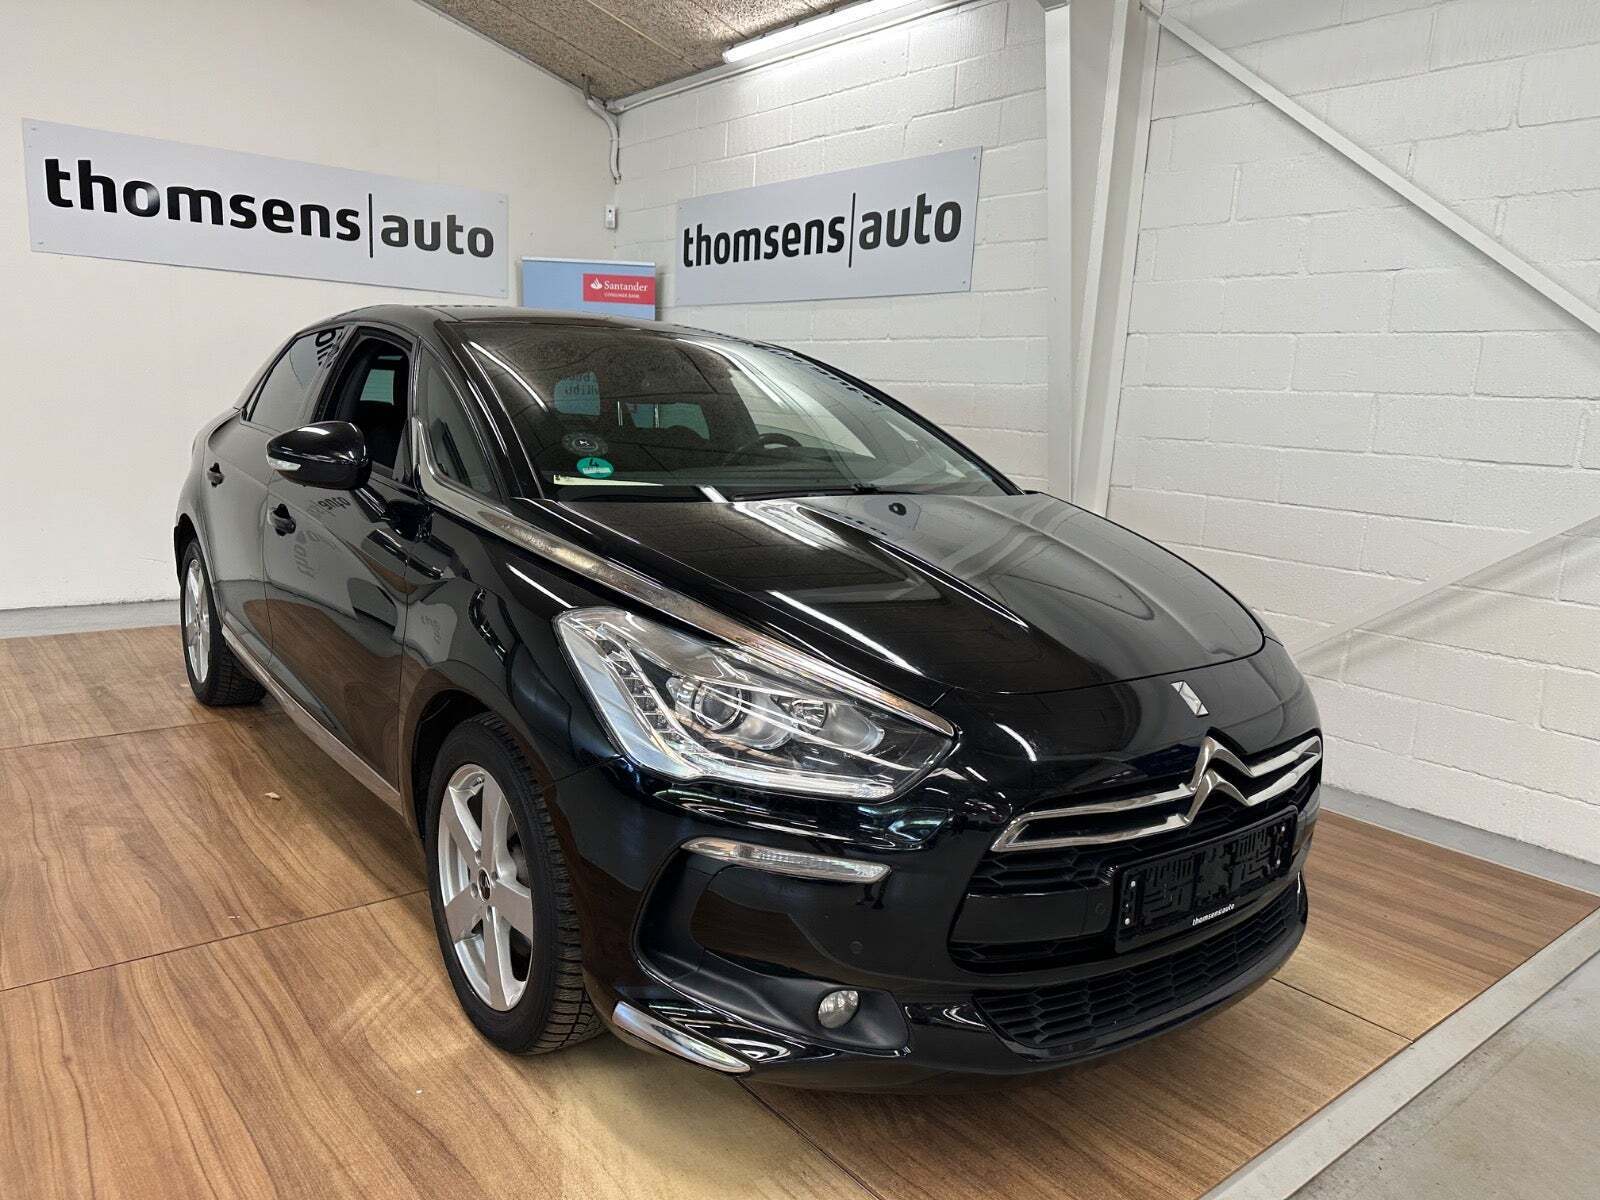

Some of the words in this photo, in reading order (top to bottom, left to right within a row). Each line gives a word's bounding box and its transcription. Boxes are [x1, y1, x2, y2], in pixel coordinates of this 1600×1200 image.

[44, 158, 361, 242] thomsens
[380, 214, 495, 259] auto
[683, 217, 846, 267] thomsens
[858, 192, 962, 250] auto
[603, 280, 648, 292] Santander
